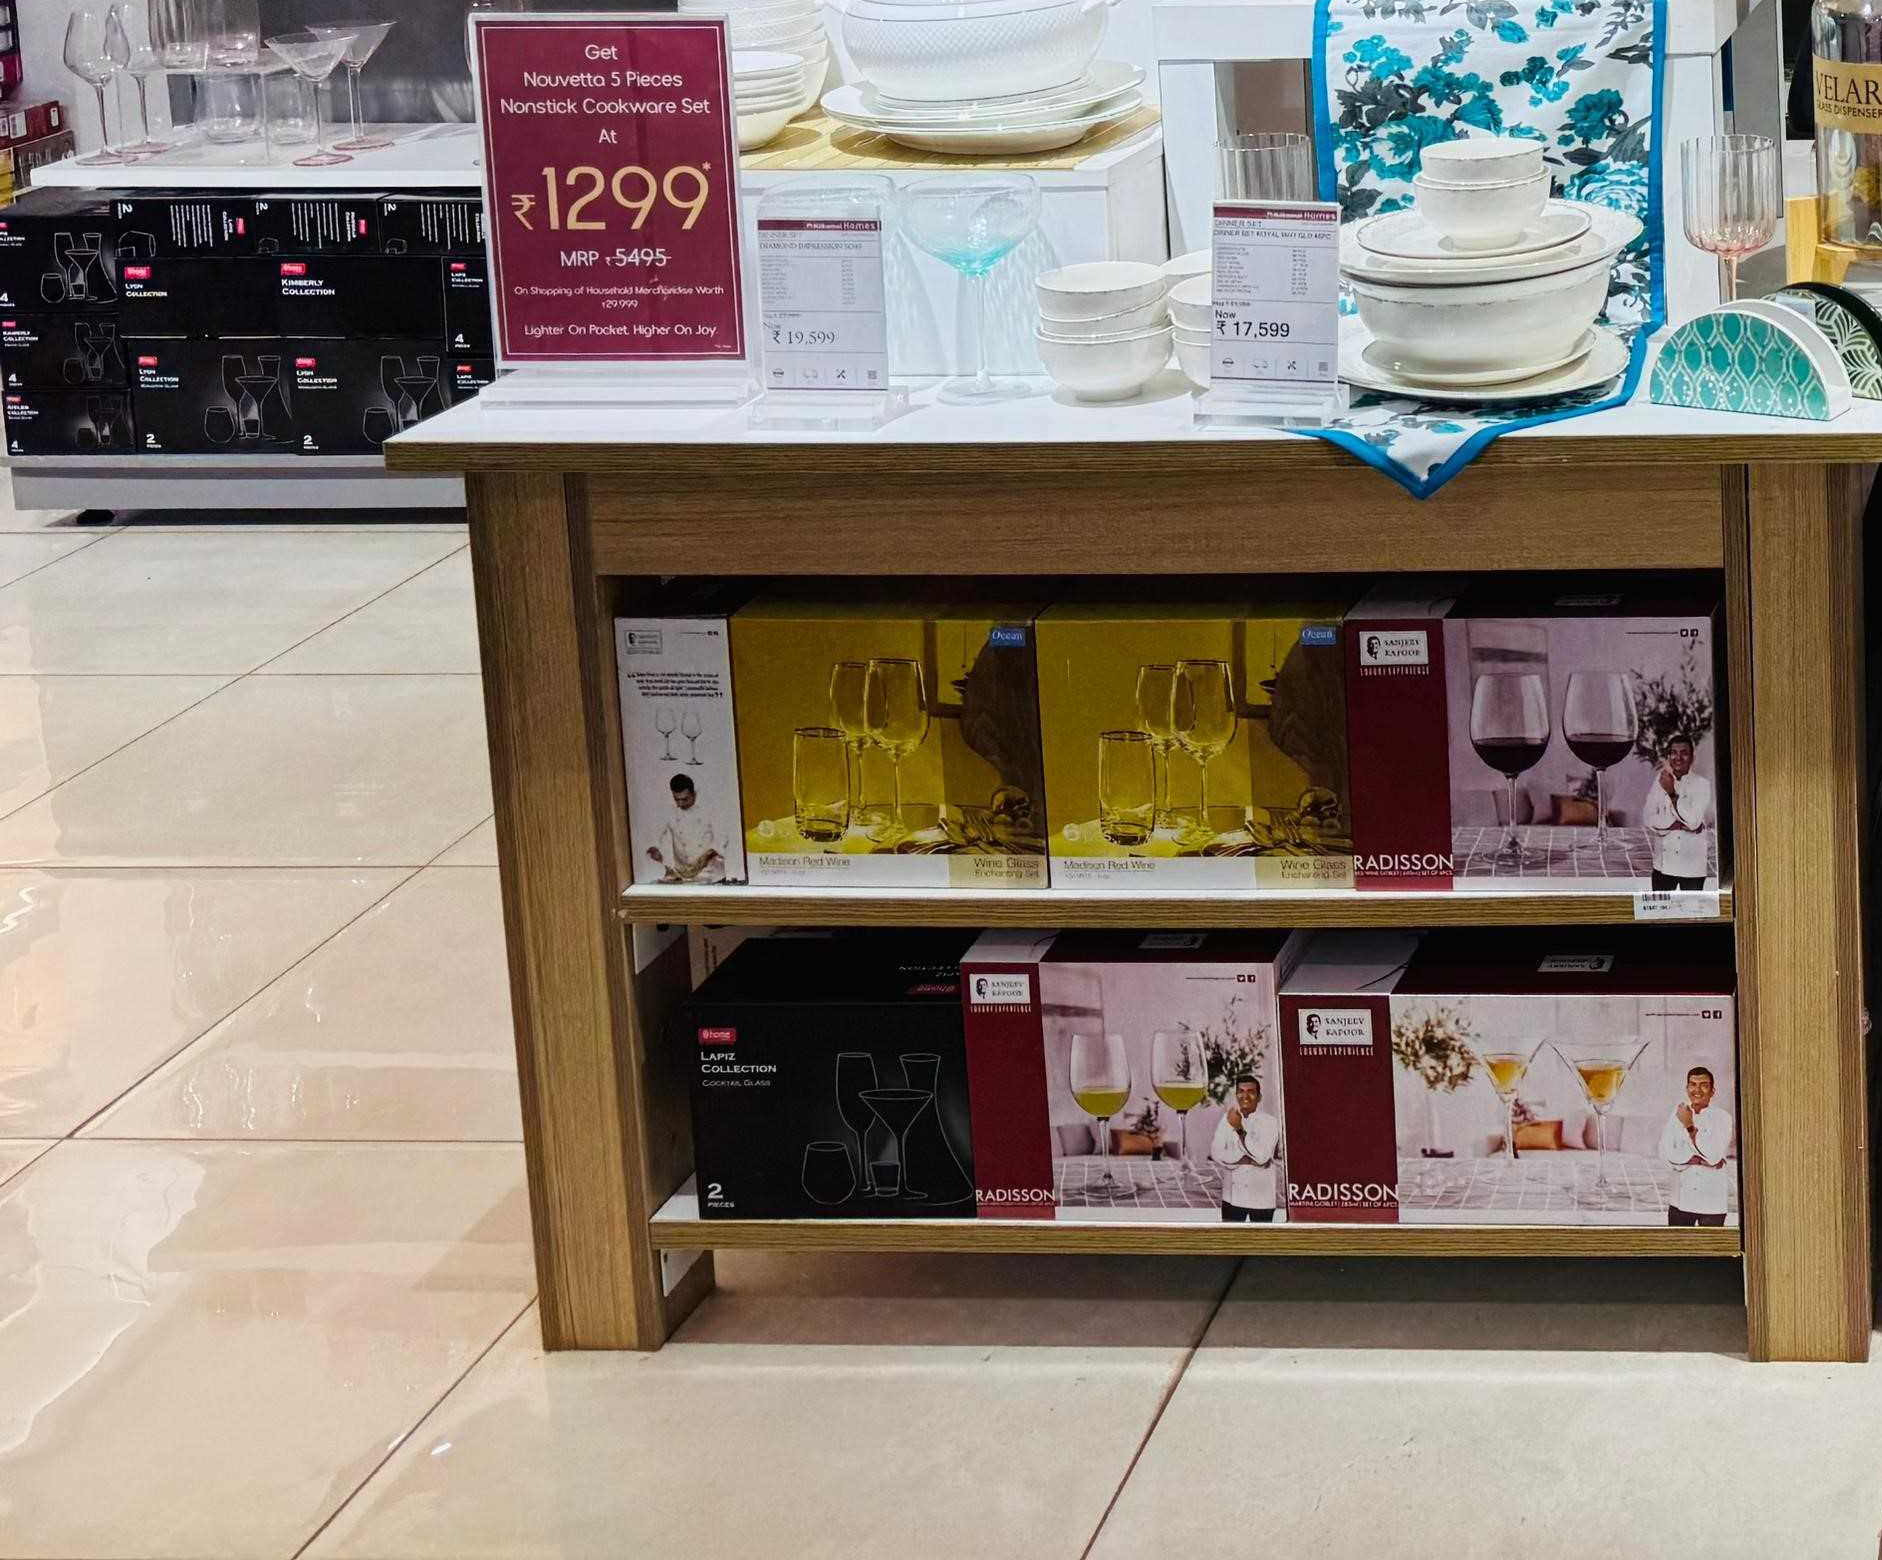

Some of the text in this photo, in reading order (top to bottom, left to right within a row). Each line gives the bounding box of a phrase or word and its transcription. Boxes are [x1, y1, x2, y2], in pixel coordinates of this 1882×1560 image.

[585, 44, 618, 60] Get
[524, 71, 683, 87] Nouvetta 5 Pieces
[501, 98, 711, 114] Nonstick Cookware Set
[598, 129, 618, 144] At
[843, 221, 876, 231] Homes
[560, 251, 599, 267] MRP
[282, 288, 336, 296] COLLECTION
[514, 286, 530, 295] On
[530, 286, 573, 299] Shopping
[574, 286, 585, 295] of
[586, 286, 634, 295] Household
[695, 286, 724, 295] Worth
[1215, 309, 1237, 319] Now
[524, 324, 564, 337] Lighter
[568, 324, 587, 335] On
[633, 324, 671, 337] Higher
[674, 324, 693, 335] On
[1216, 320, 1290, 338] ₹ 17,599
[455, 333, 464, 343] 4
[786, 330, 836, 346] 19,599
[146, 433, 155, 443] 2
[303, 435, 313, 445] 2
[991, 629, 1023, 642] Ocean
[1302, 628, 1334, 641] Ocean
[1353, 853, 1454, 871] RADISSON
[700, 1051, 736, 1061] LAPIZ
[701, 1064, 777, 1074] COLLECTION
[707, 1183, 724, 1199] 2
[975, 1189, 1056, 1202] RADISSON
[1288, 1183, 1399, 1201] RADISSON
